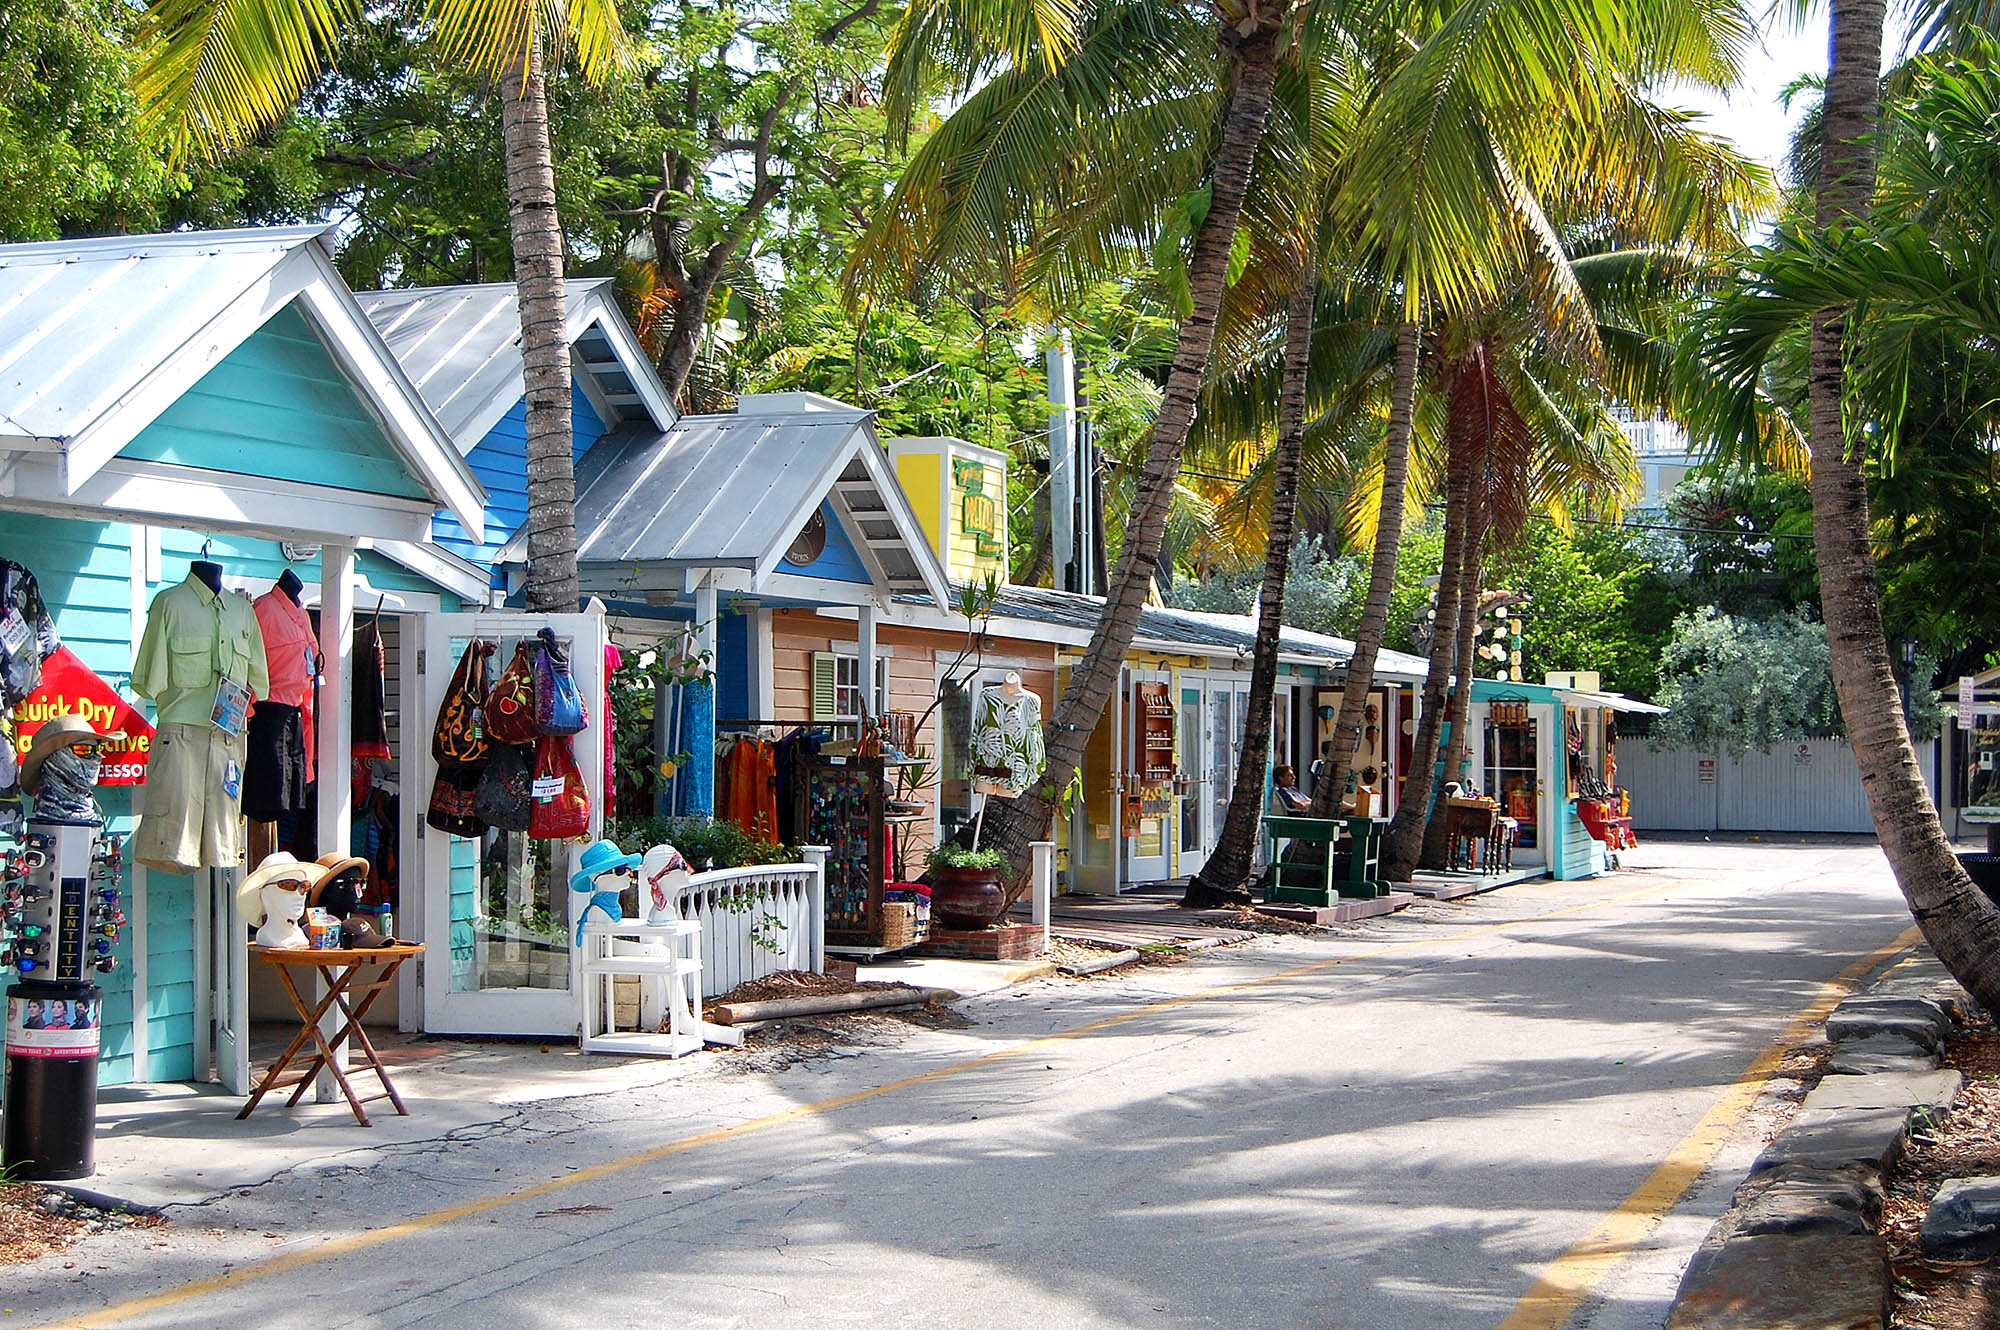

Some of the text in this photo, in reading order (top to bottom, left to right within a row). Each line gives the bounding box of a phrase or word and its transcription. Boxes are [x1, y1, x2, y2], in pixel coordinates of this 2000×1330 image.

[13, 694, 116, 730] Quick Dry
[64, 882, 78, 977] IDENTITY
